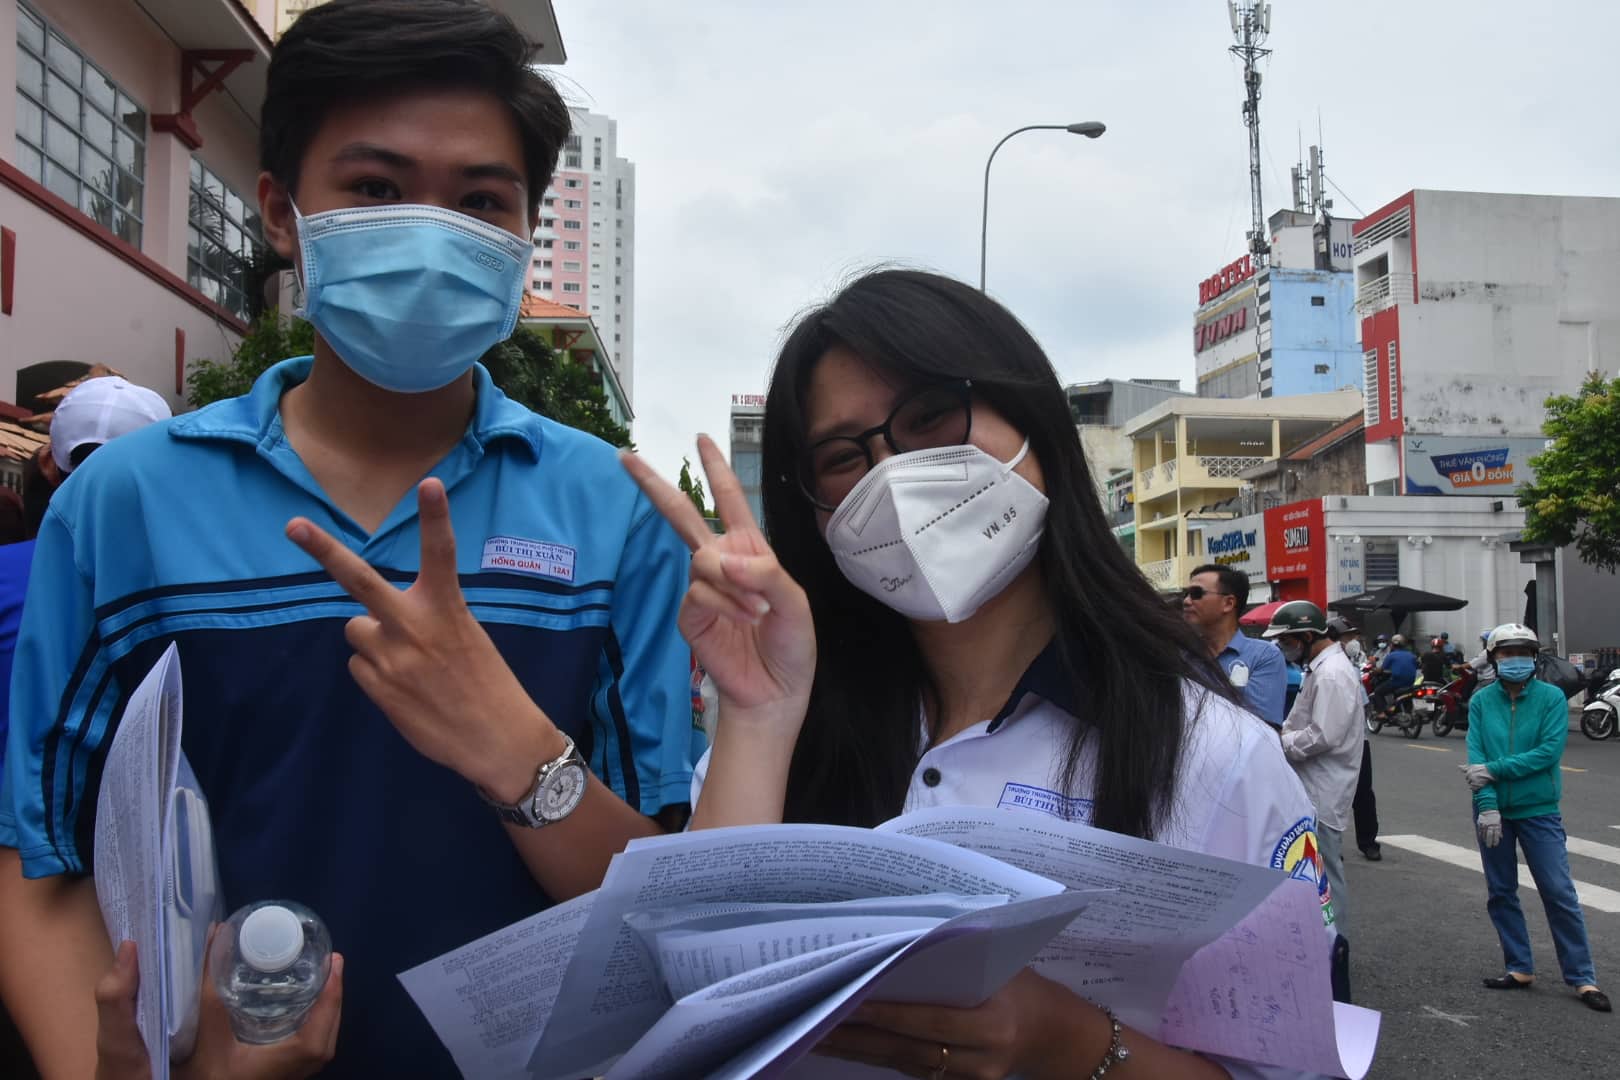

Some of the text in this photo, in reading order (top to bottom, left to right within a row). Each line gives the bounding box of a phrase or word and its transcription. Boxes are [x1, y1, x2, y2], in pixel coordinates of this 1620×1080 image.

[1333, 242, 1356, 258] HOT
[1199, 254, 1256, 305] HOTEL
[1453, 470, 1472, 483] GIÁ
[1471, 461, 1486, 482] 0
[1284, 526, 1308, 548] SUMATO
[516, 547, 533, 557] THỊ
[535, 550, 563, 561] XUÂN
